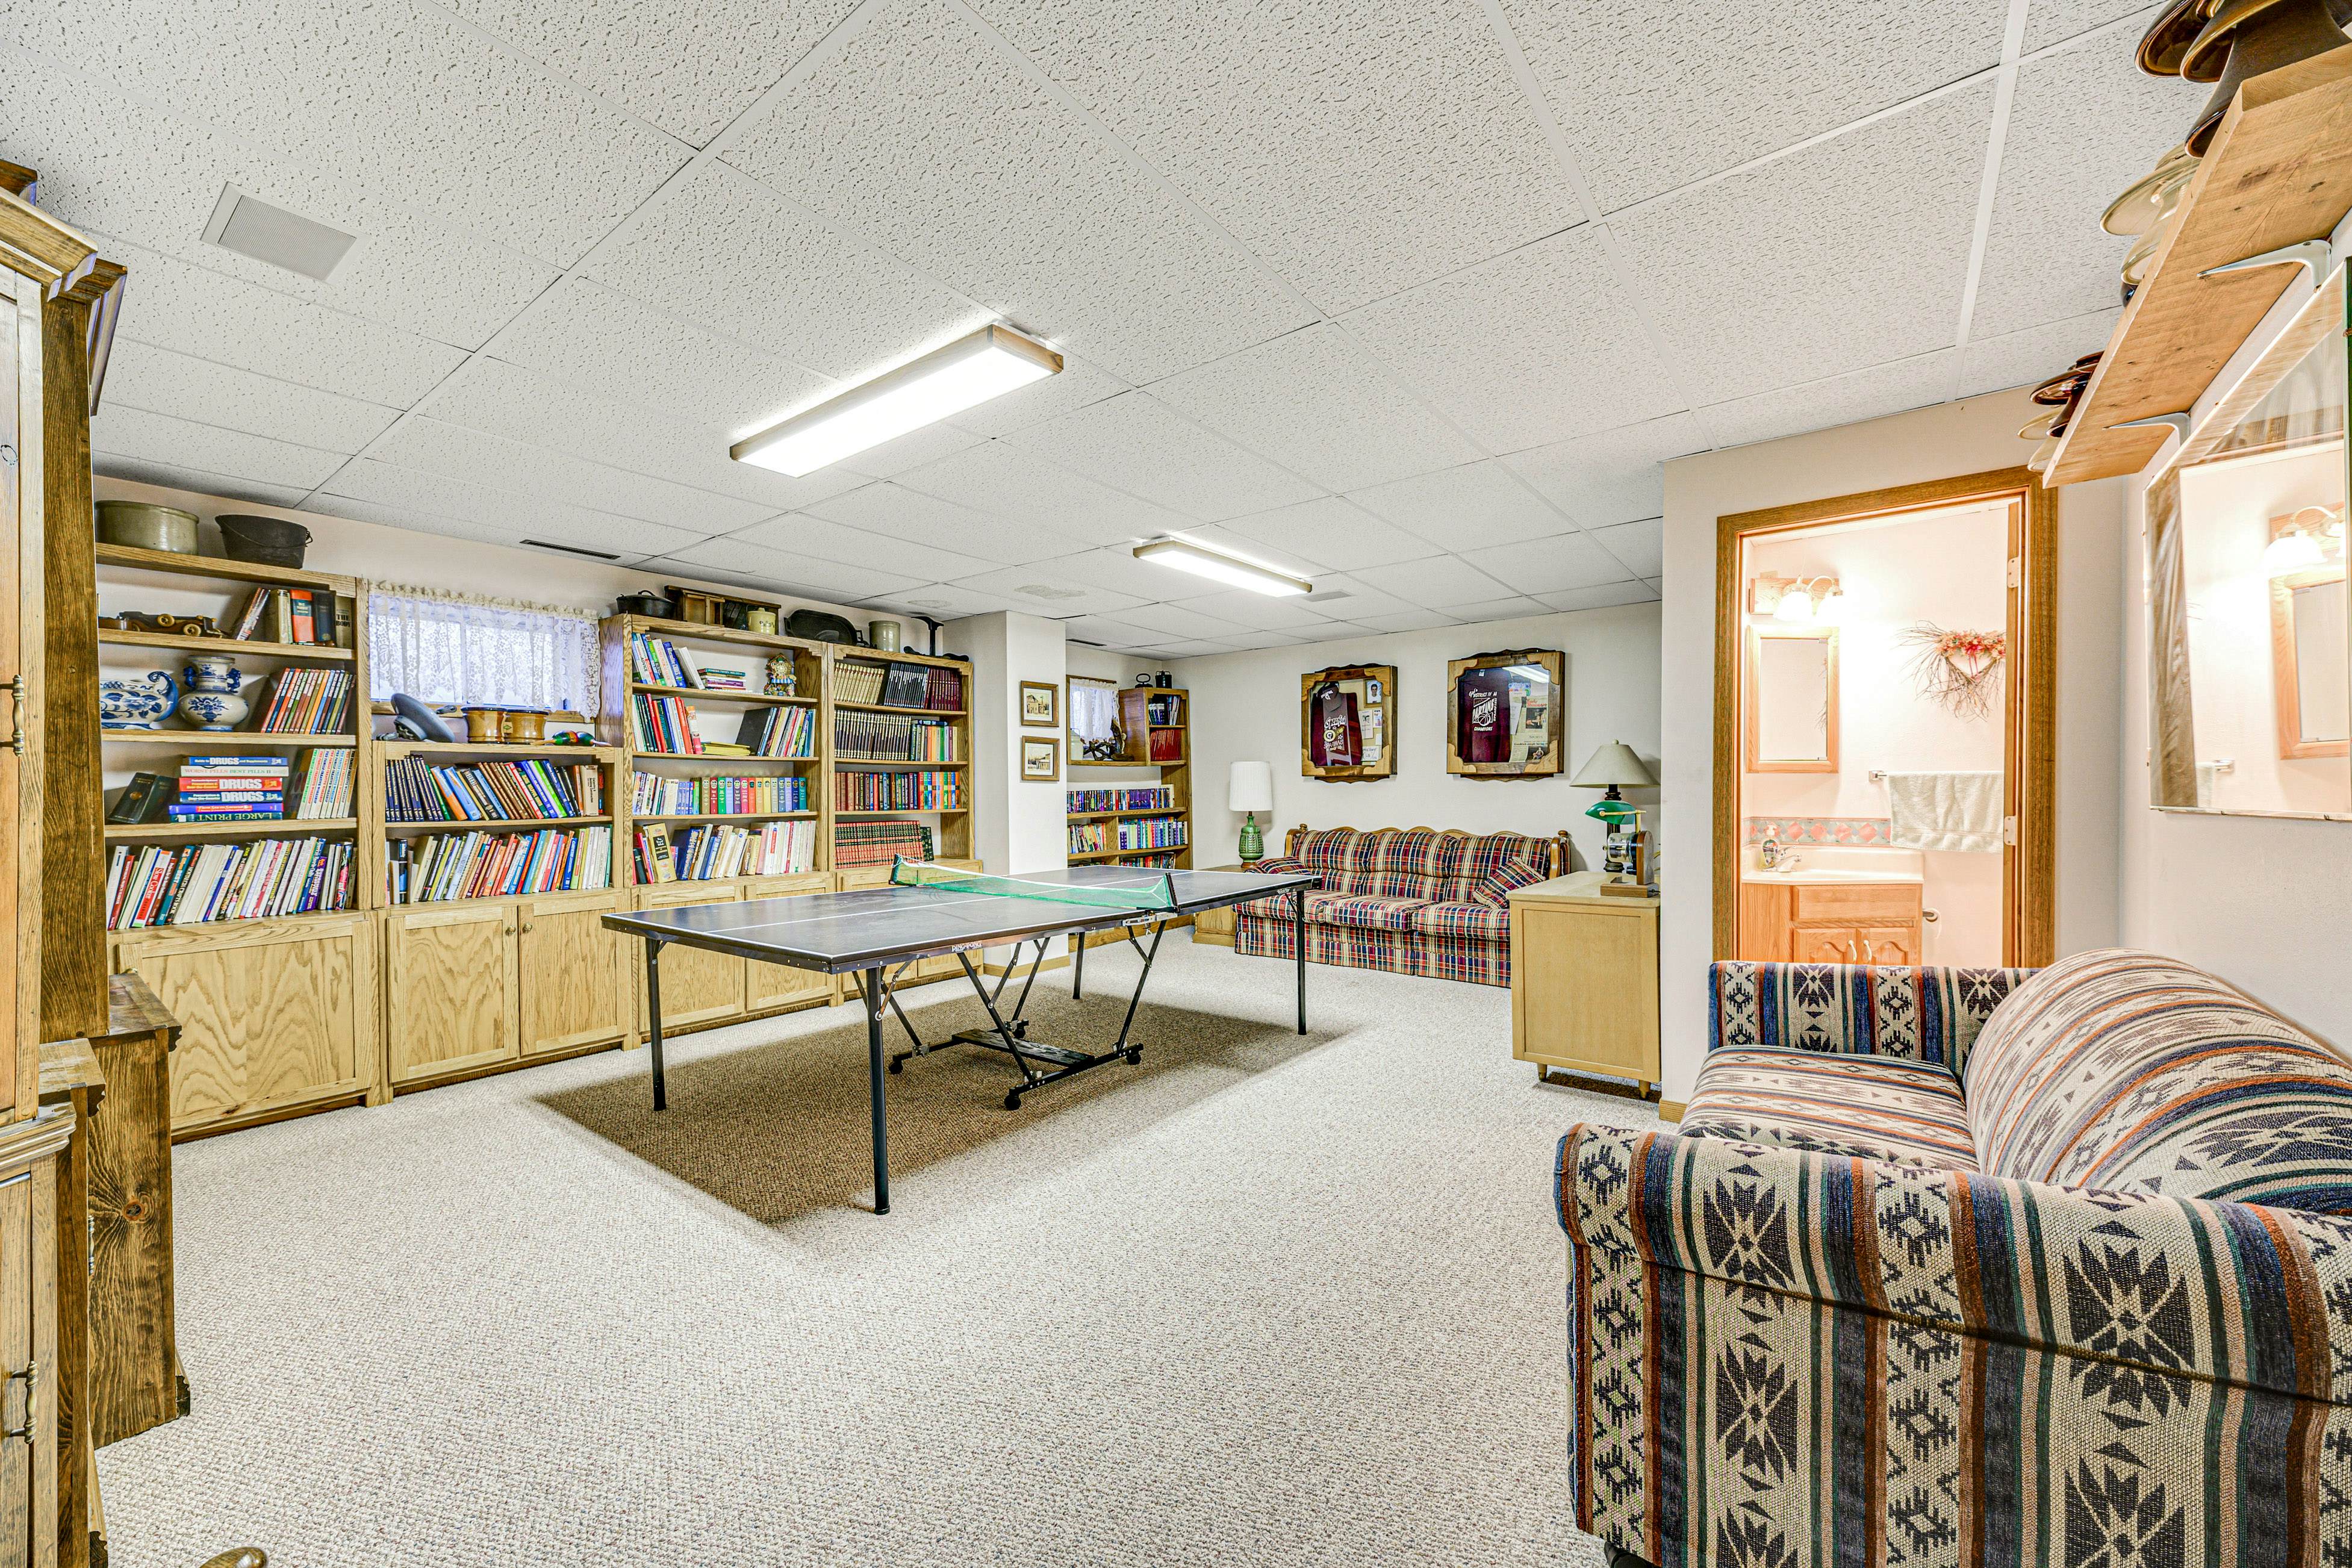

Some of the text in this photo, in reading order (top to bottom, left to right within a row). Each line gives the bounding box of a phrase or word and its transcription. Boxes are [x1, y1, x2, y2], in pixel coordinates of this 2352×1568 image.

[219, 779, 262, 789] DRUGS
[221, 792, 264, 802] DRUGS
[153, 868, 163, 880] Slow
[182, 866, 193, 887] NOSTALGIA
[146, 882, 158, 899] Cooker
[176, 887, 184, 902] CRAFTS
[952, 941, 982, 952] PING-PONG
